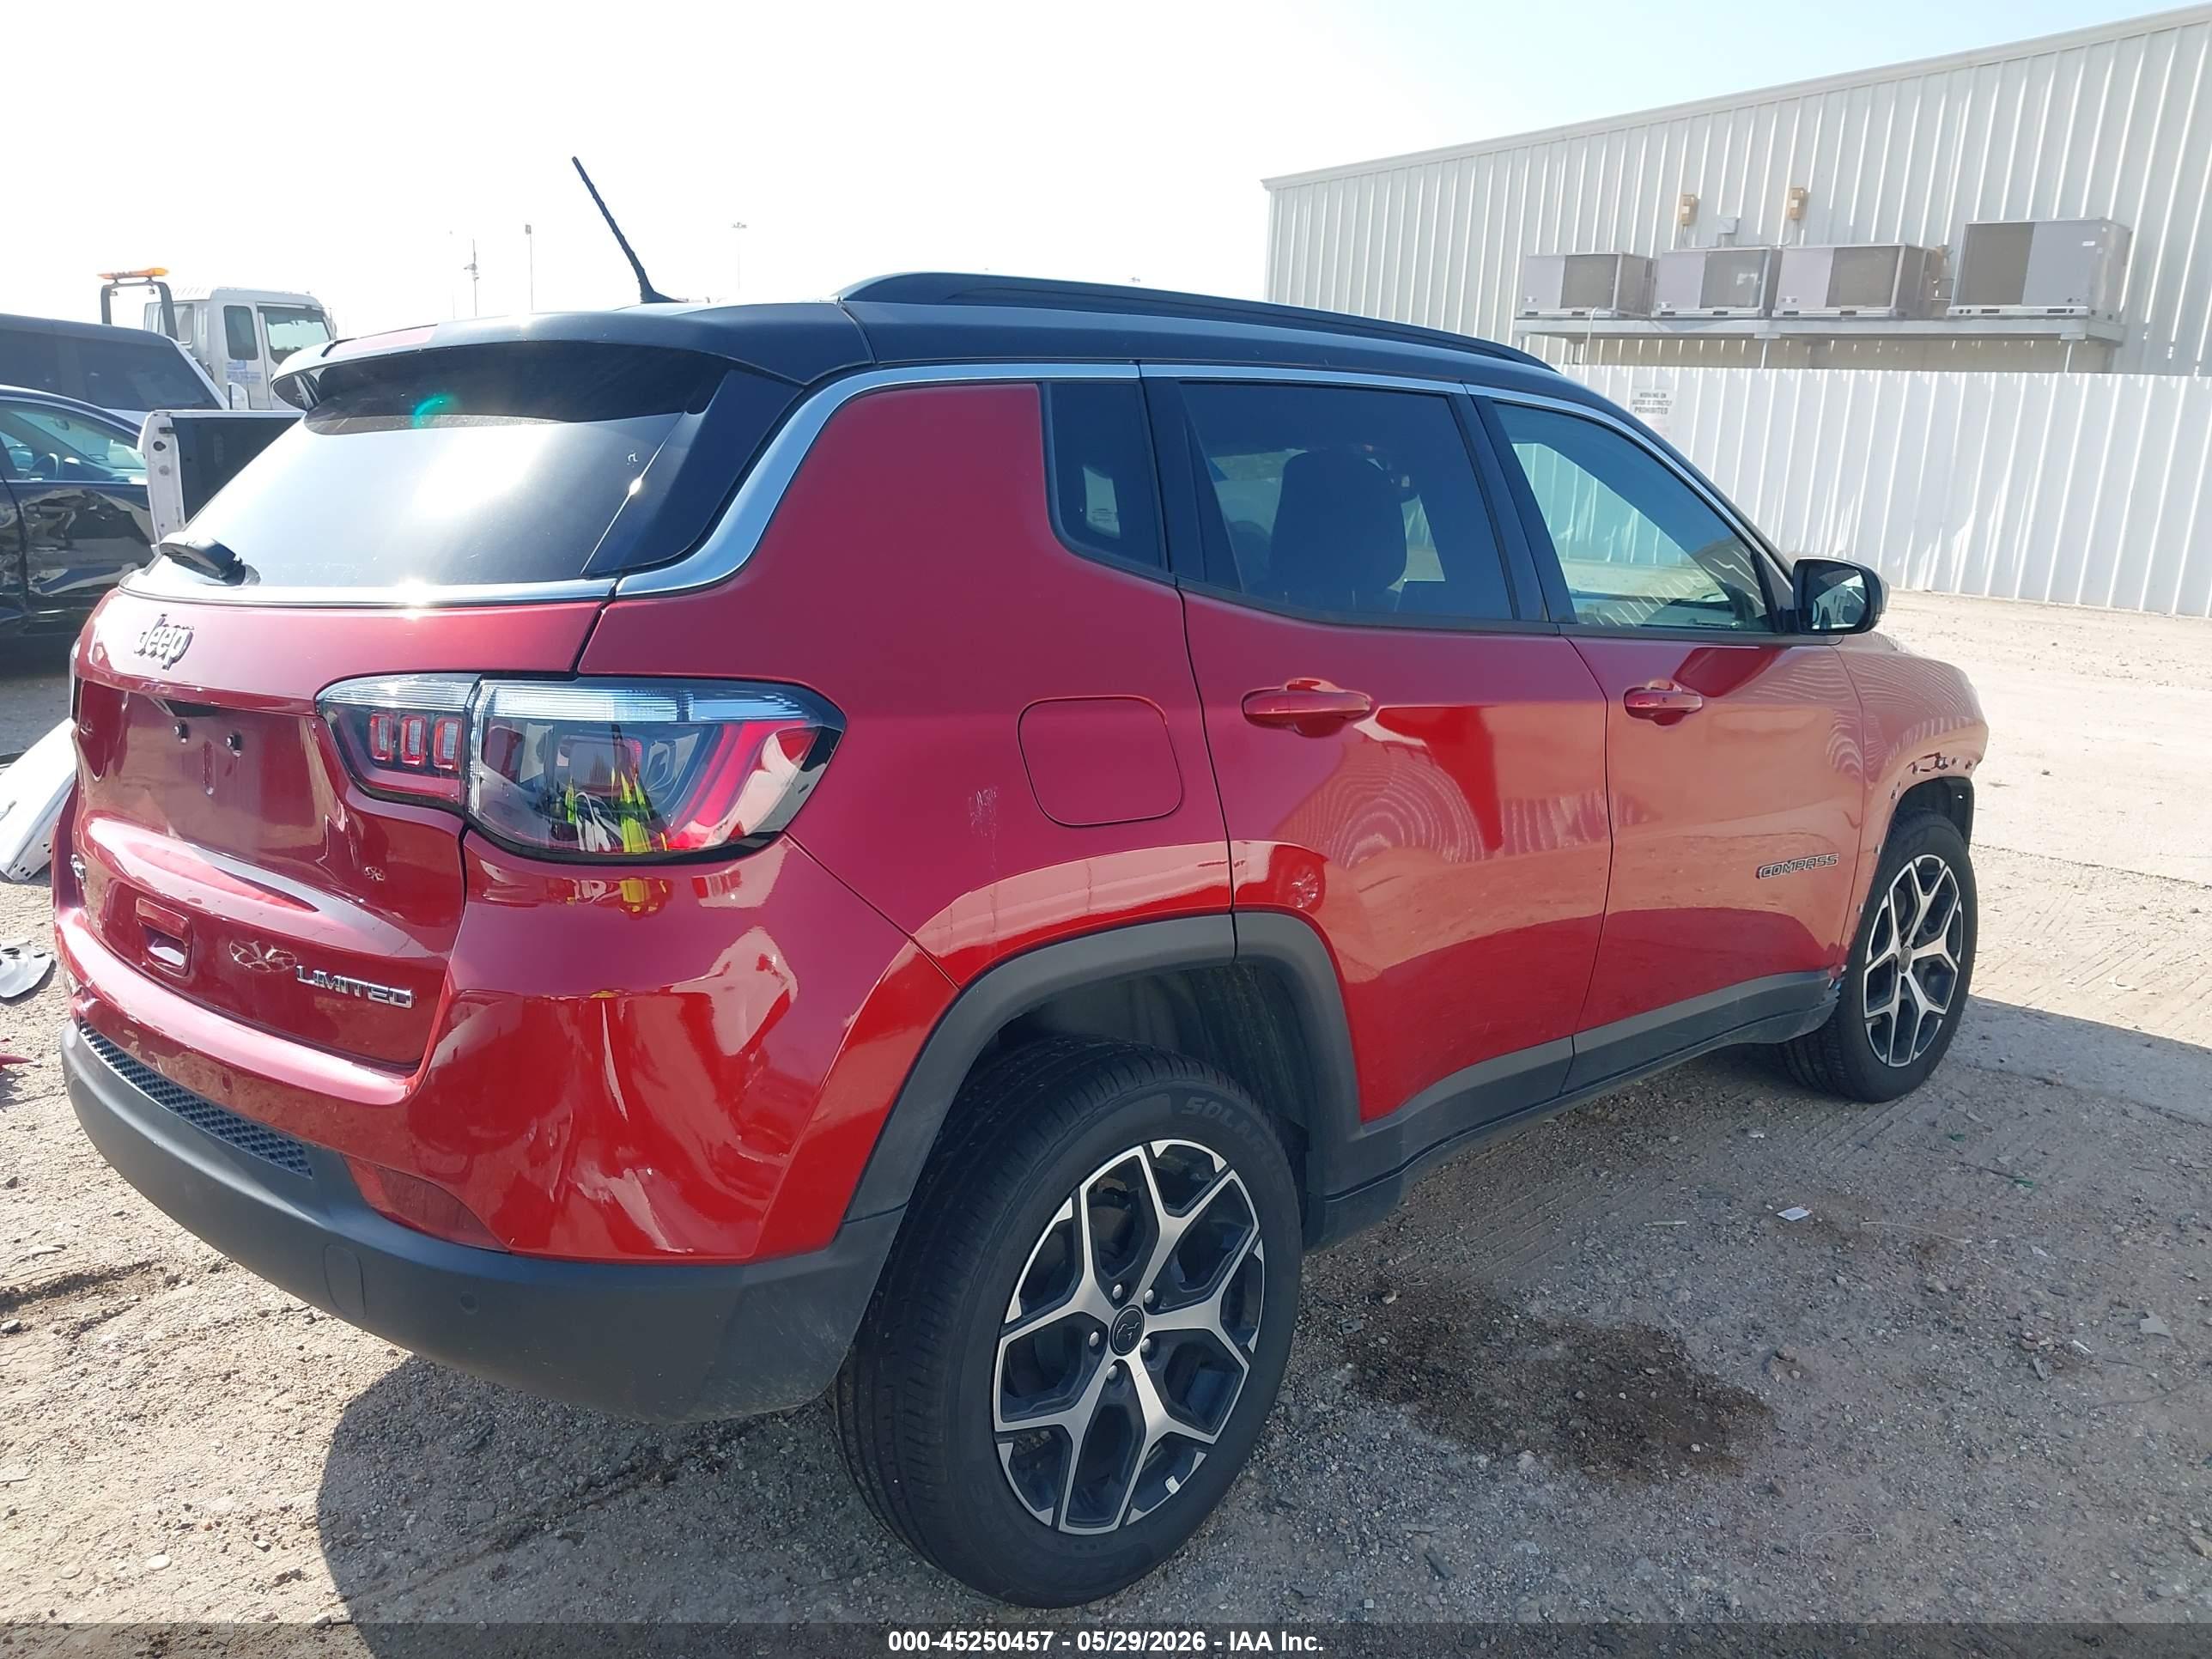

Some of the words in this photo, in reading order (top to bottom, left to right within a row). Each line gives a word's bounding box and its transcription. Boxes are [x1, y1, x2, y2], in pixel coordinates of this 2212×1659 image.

[134, 613, 194, 671] Jeep
[1757, 853, 1838, 879] COMPASS
[295, 964, 414, 1009] LIMITED
